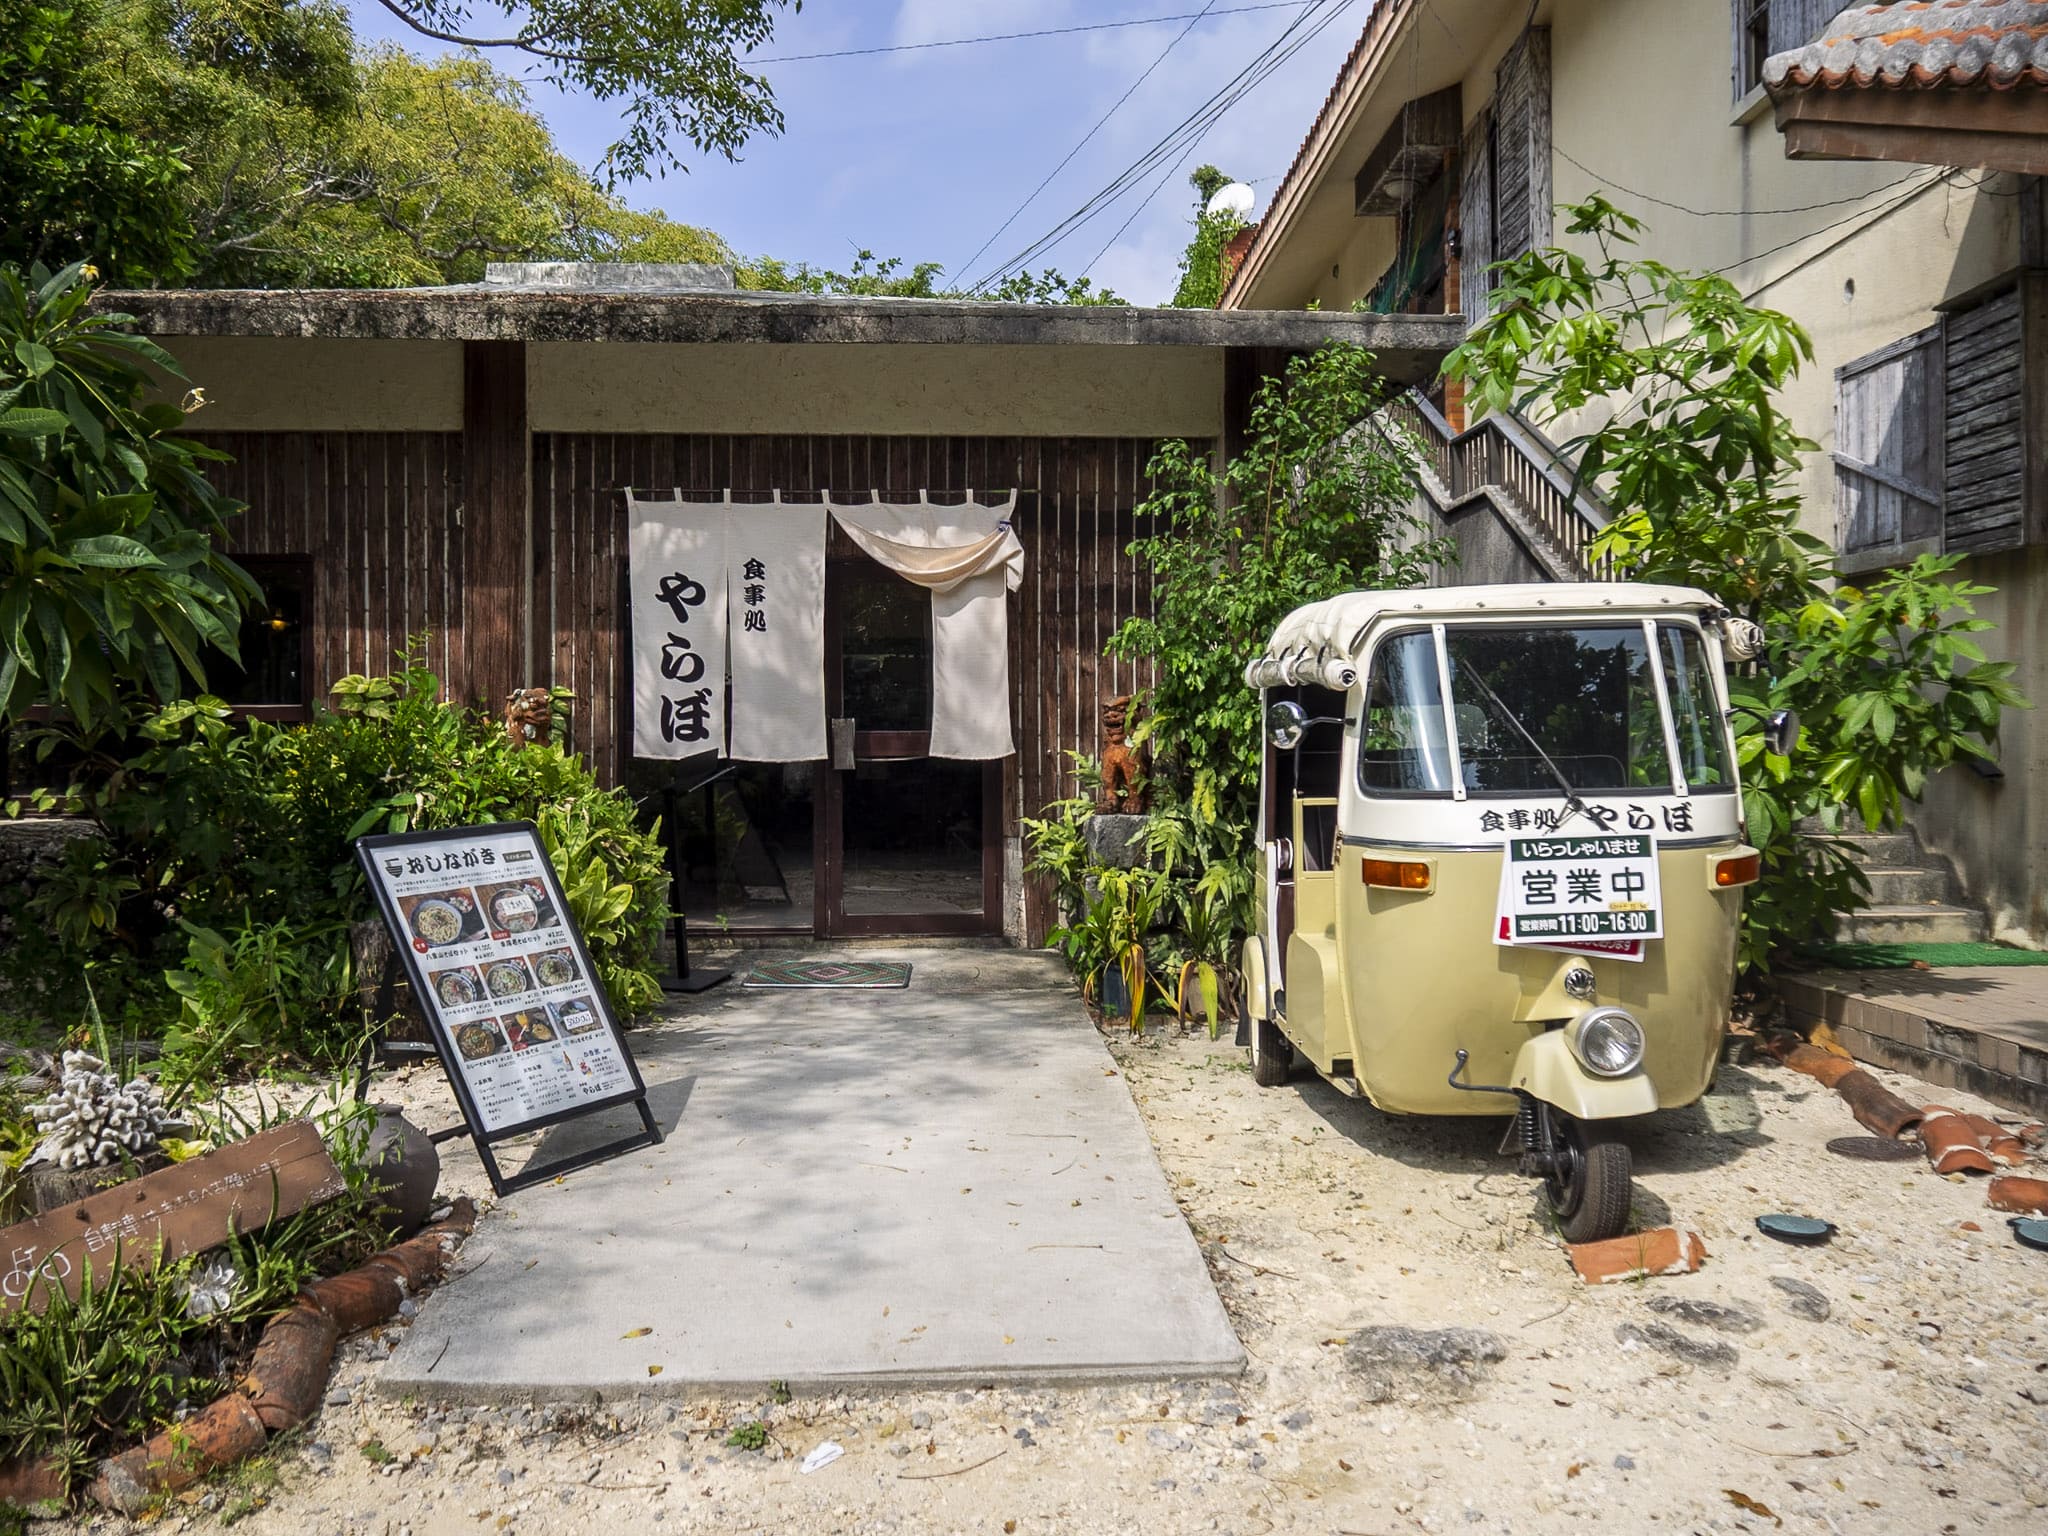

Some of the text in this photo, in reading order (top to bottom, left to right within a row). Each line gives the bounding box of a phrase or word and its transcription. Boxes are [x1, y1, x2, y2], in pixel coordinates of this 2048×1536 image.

[742, 557, 767, 633] 食事処
[655, 572, 713, 744] やらぼ
[1479, 801, 1693, 833] 食事処 やらぼ
[406, 847, 498, 876] おしながき
[1521, 839, 1641, 858] いらっしゃいませ
[1522, 866, 1645, 905] 営業中
